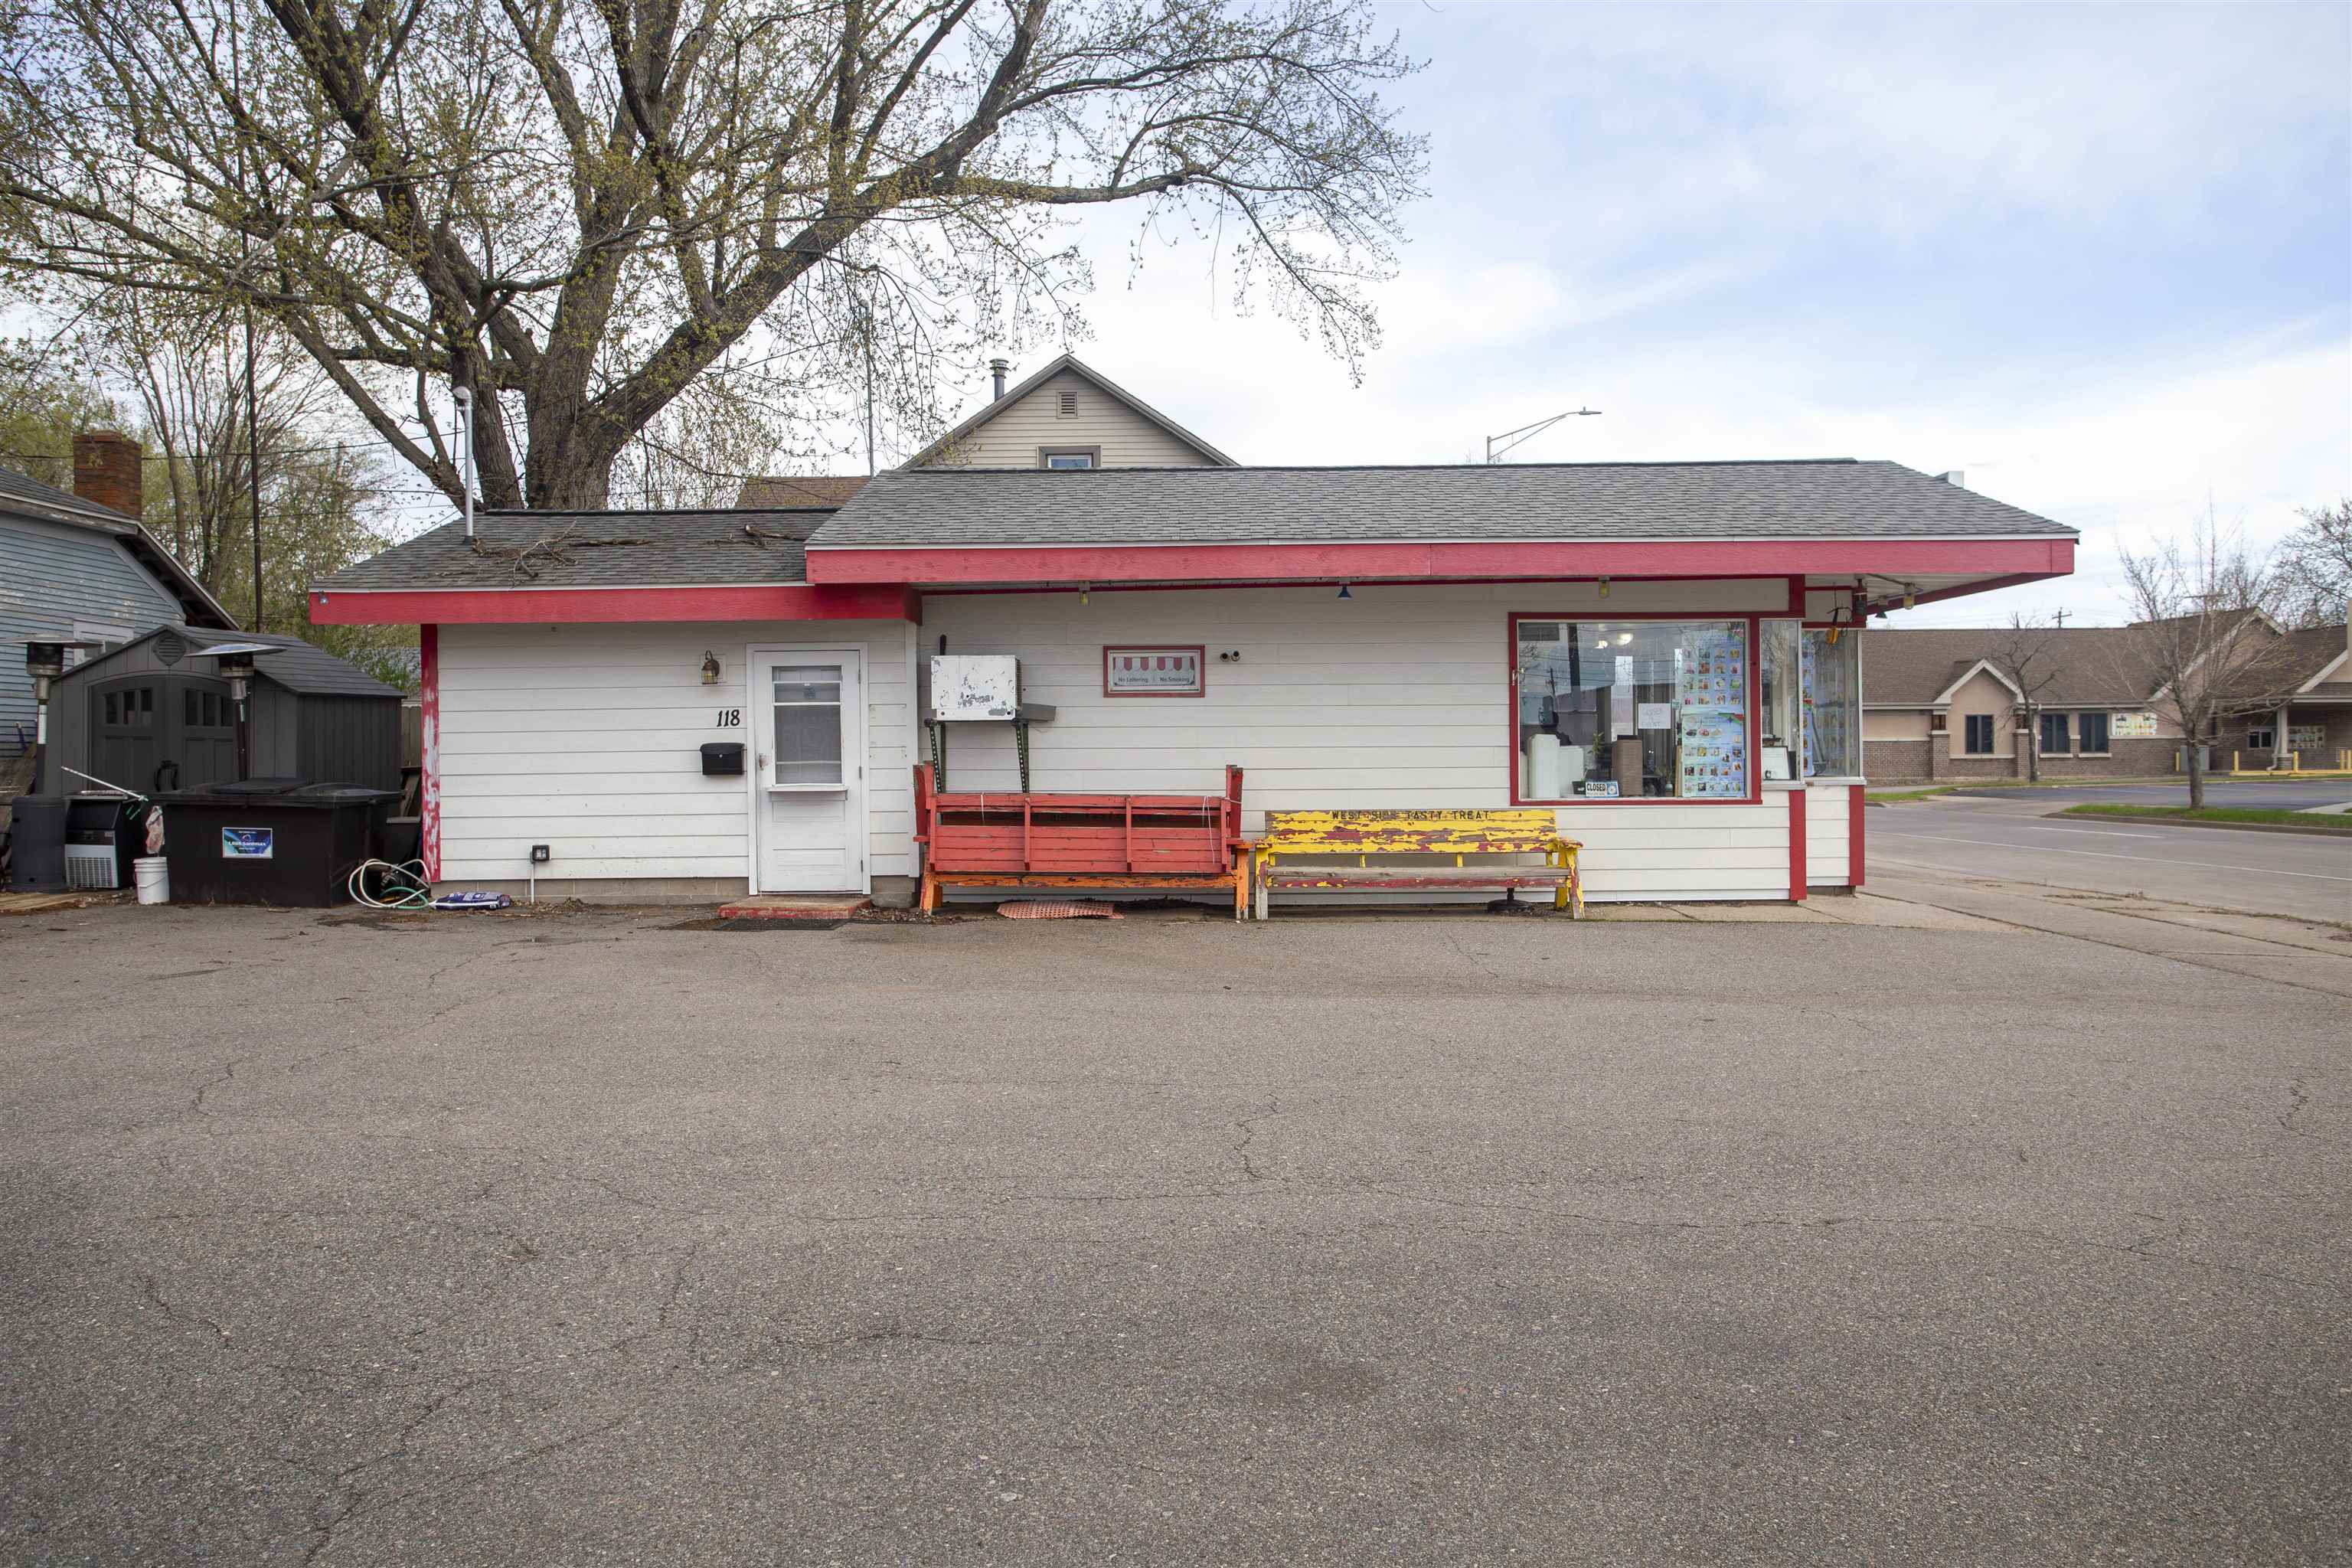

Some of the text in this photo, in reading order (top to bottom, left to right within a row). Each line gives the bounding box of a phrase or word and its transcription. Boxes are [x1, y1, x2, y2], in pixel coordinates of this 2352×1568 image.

[717, 709, 740, 727] 118
[1331, 811, 1363, 820] WEST
[1406, 811, 1442, 820] TASTY
[1452, 810, 1489, 819] TREAT
